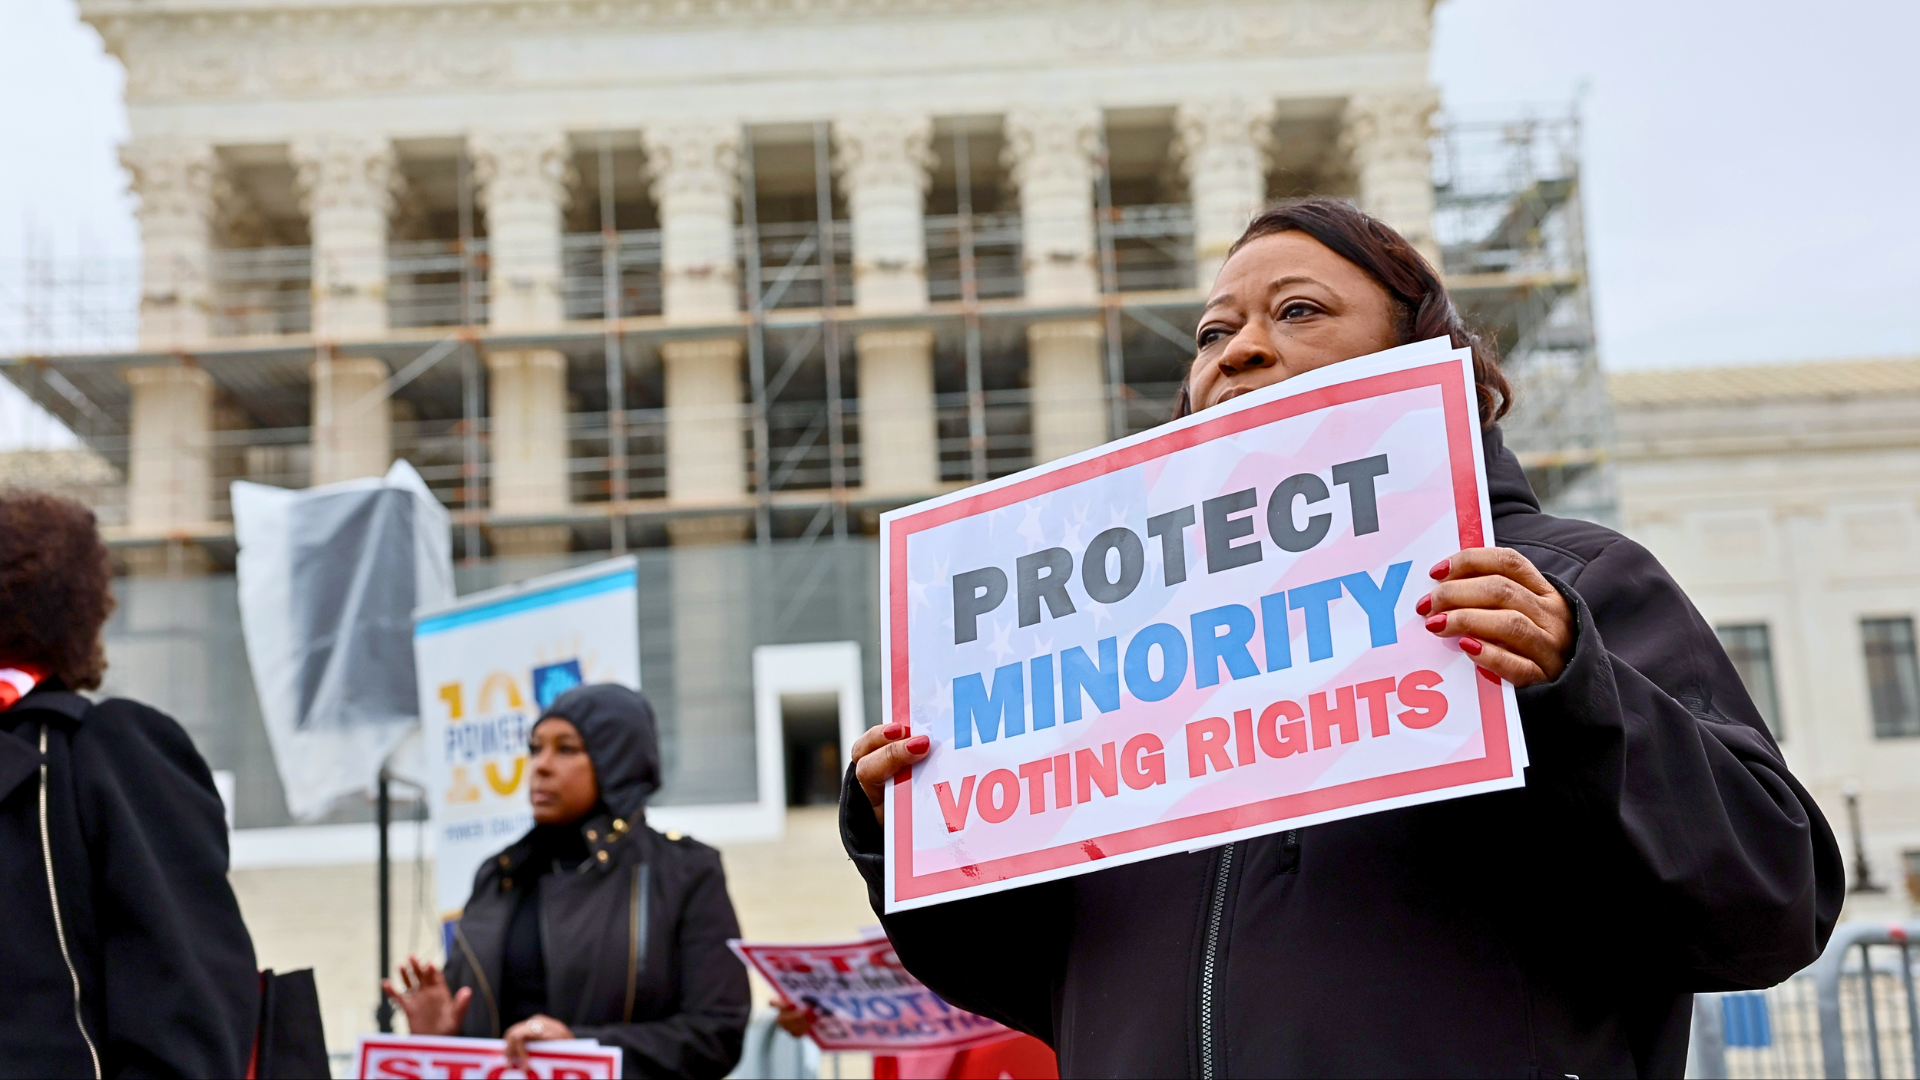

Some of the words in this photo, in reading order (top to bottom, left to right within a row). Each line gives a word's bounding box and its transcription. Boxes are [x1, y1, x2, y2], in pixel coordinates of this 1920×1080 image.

[953, 453, 1390, 645] PROTECT
[953, 560, 1413, 750] MINORITY
[934, 732, 1166, 834] VOTING
[1186, 669, 1450, 779] RIGHTS
